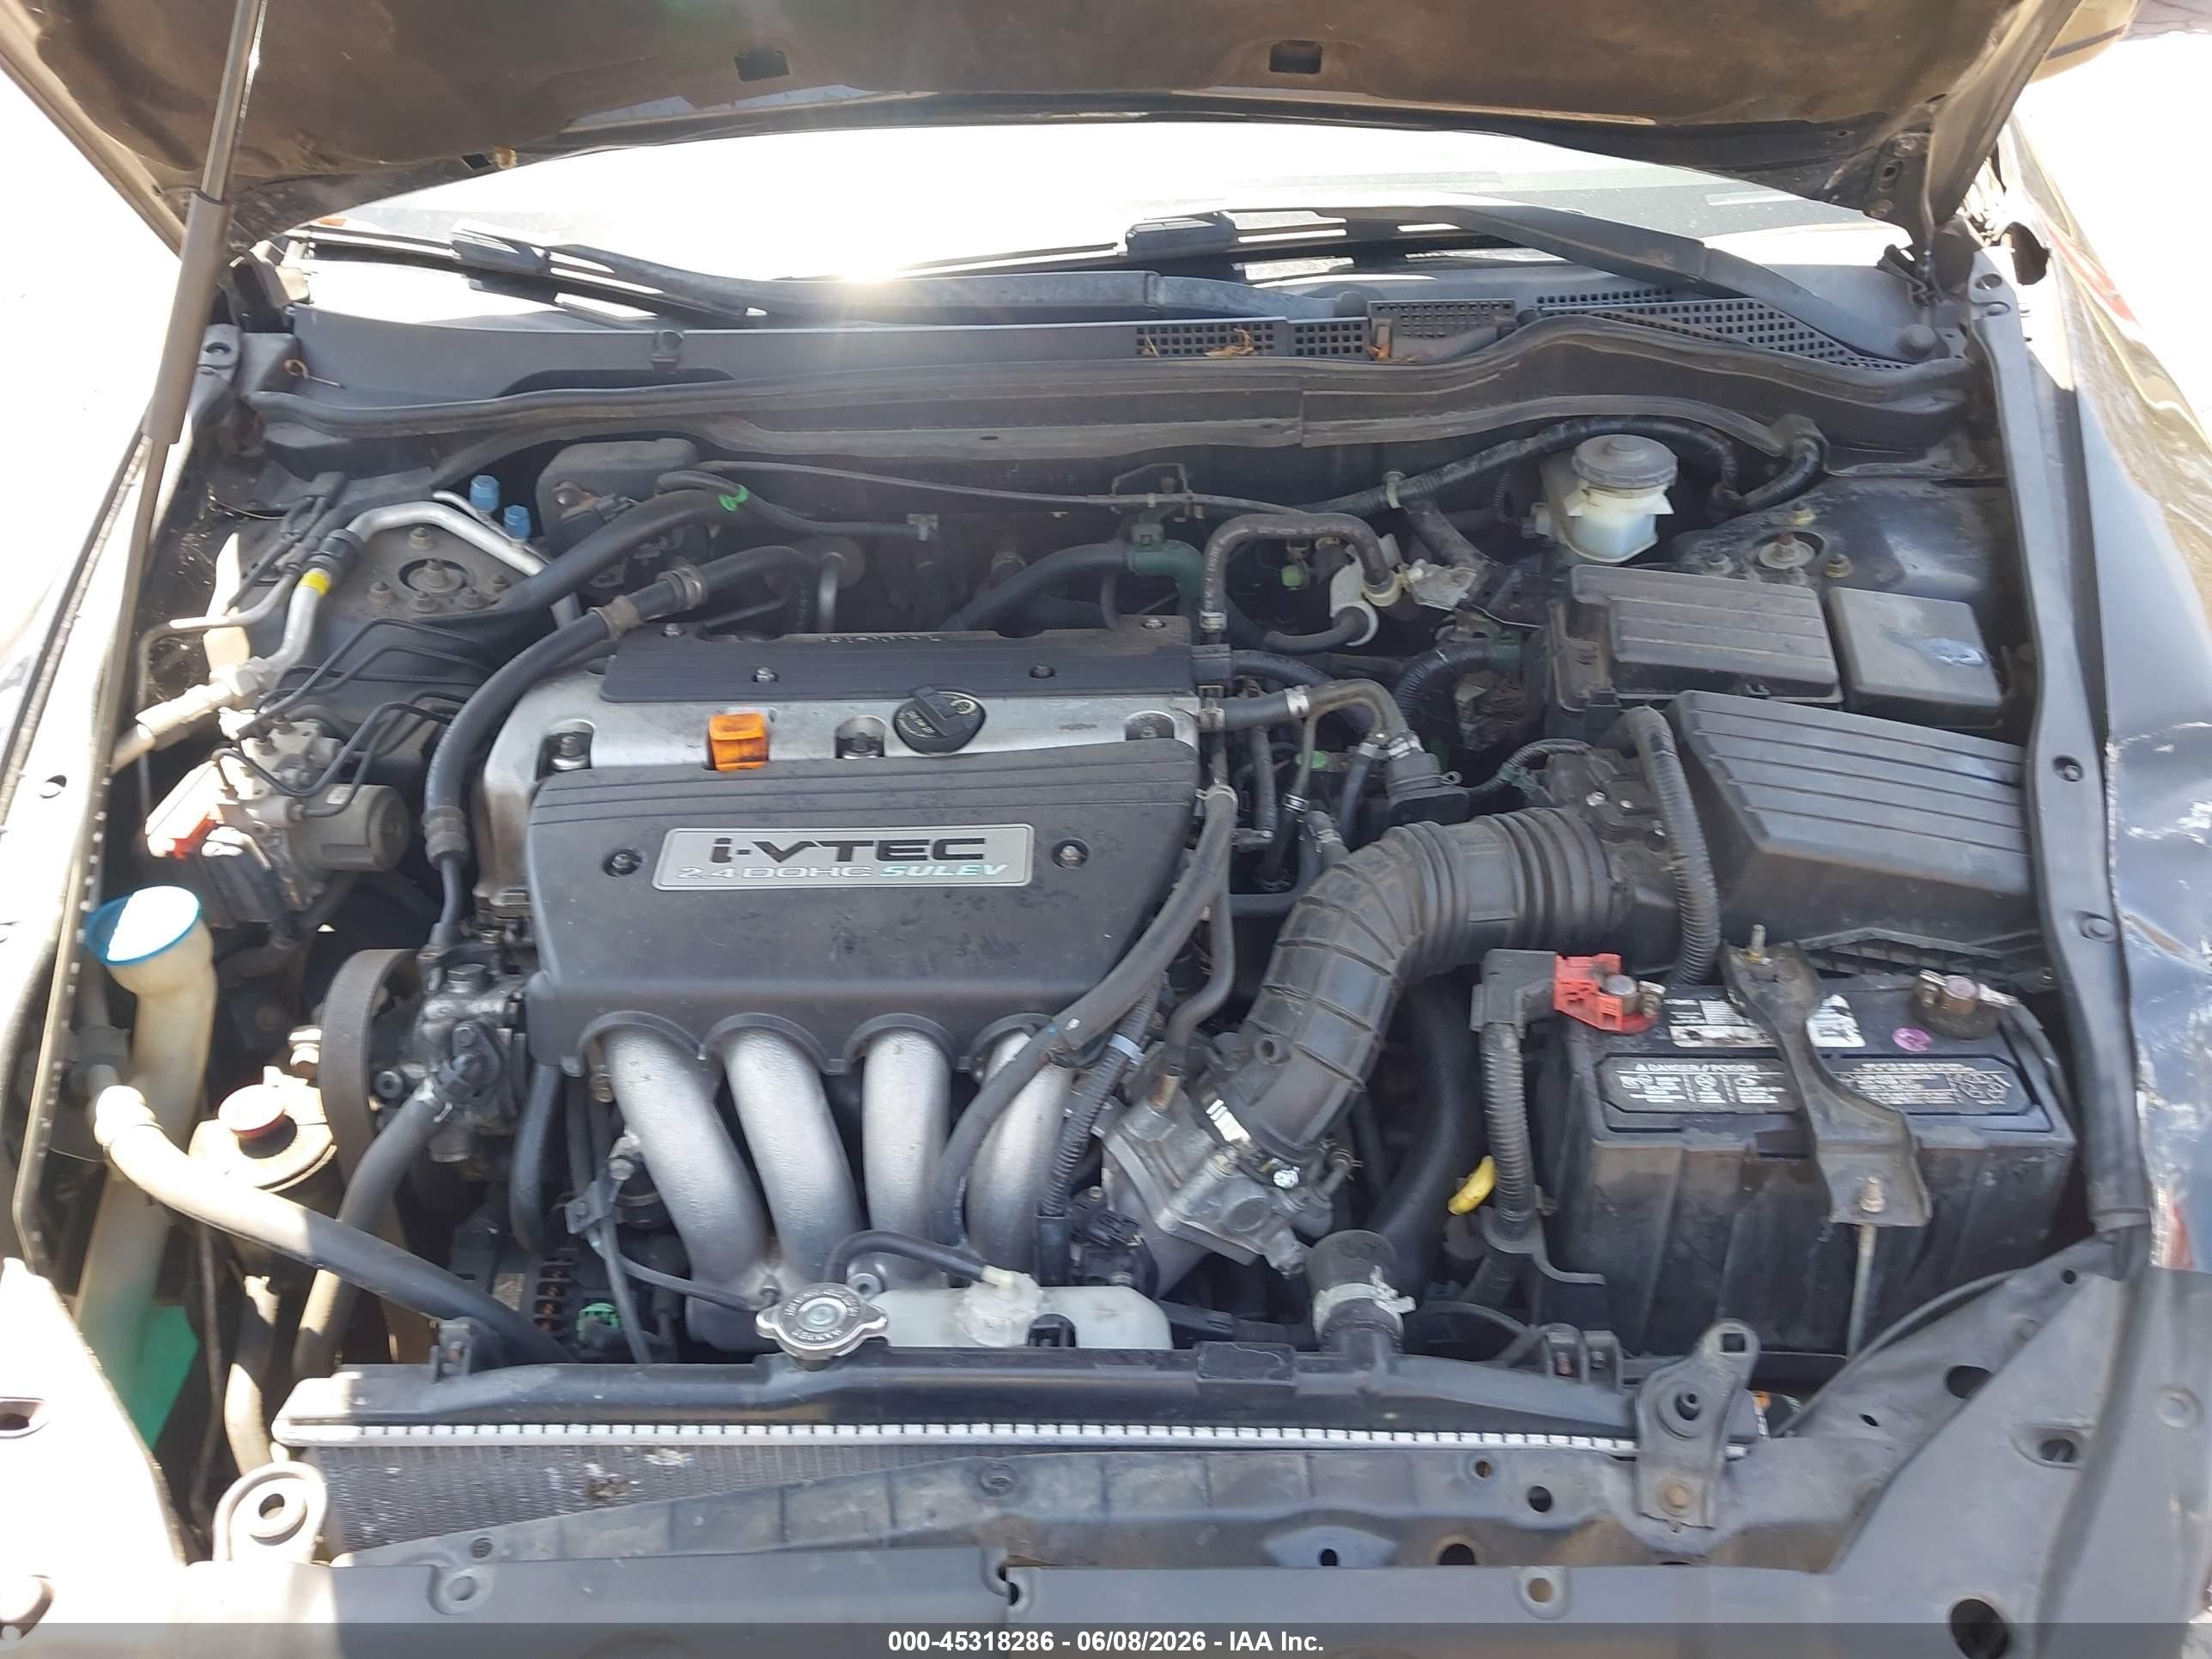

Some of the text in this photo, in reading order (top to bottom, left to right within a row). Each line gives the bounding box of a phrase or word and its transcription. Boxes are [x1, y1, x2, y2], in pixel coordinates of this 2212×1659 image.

[710, 837, 986, 864] i-VTEC
[741, 865, 874, 878] DOHC
[878, 863, 1010, 878] SULEV
